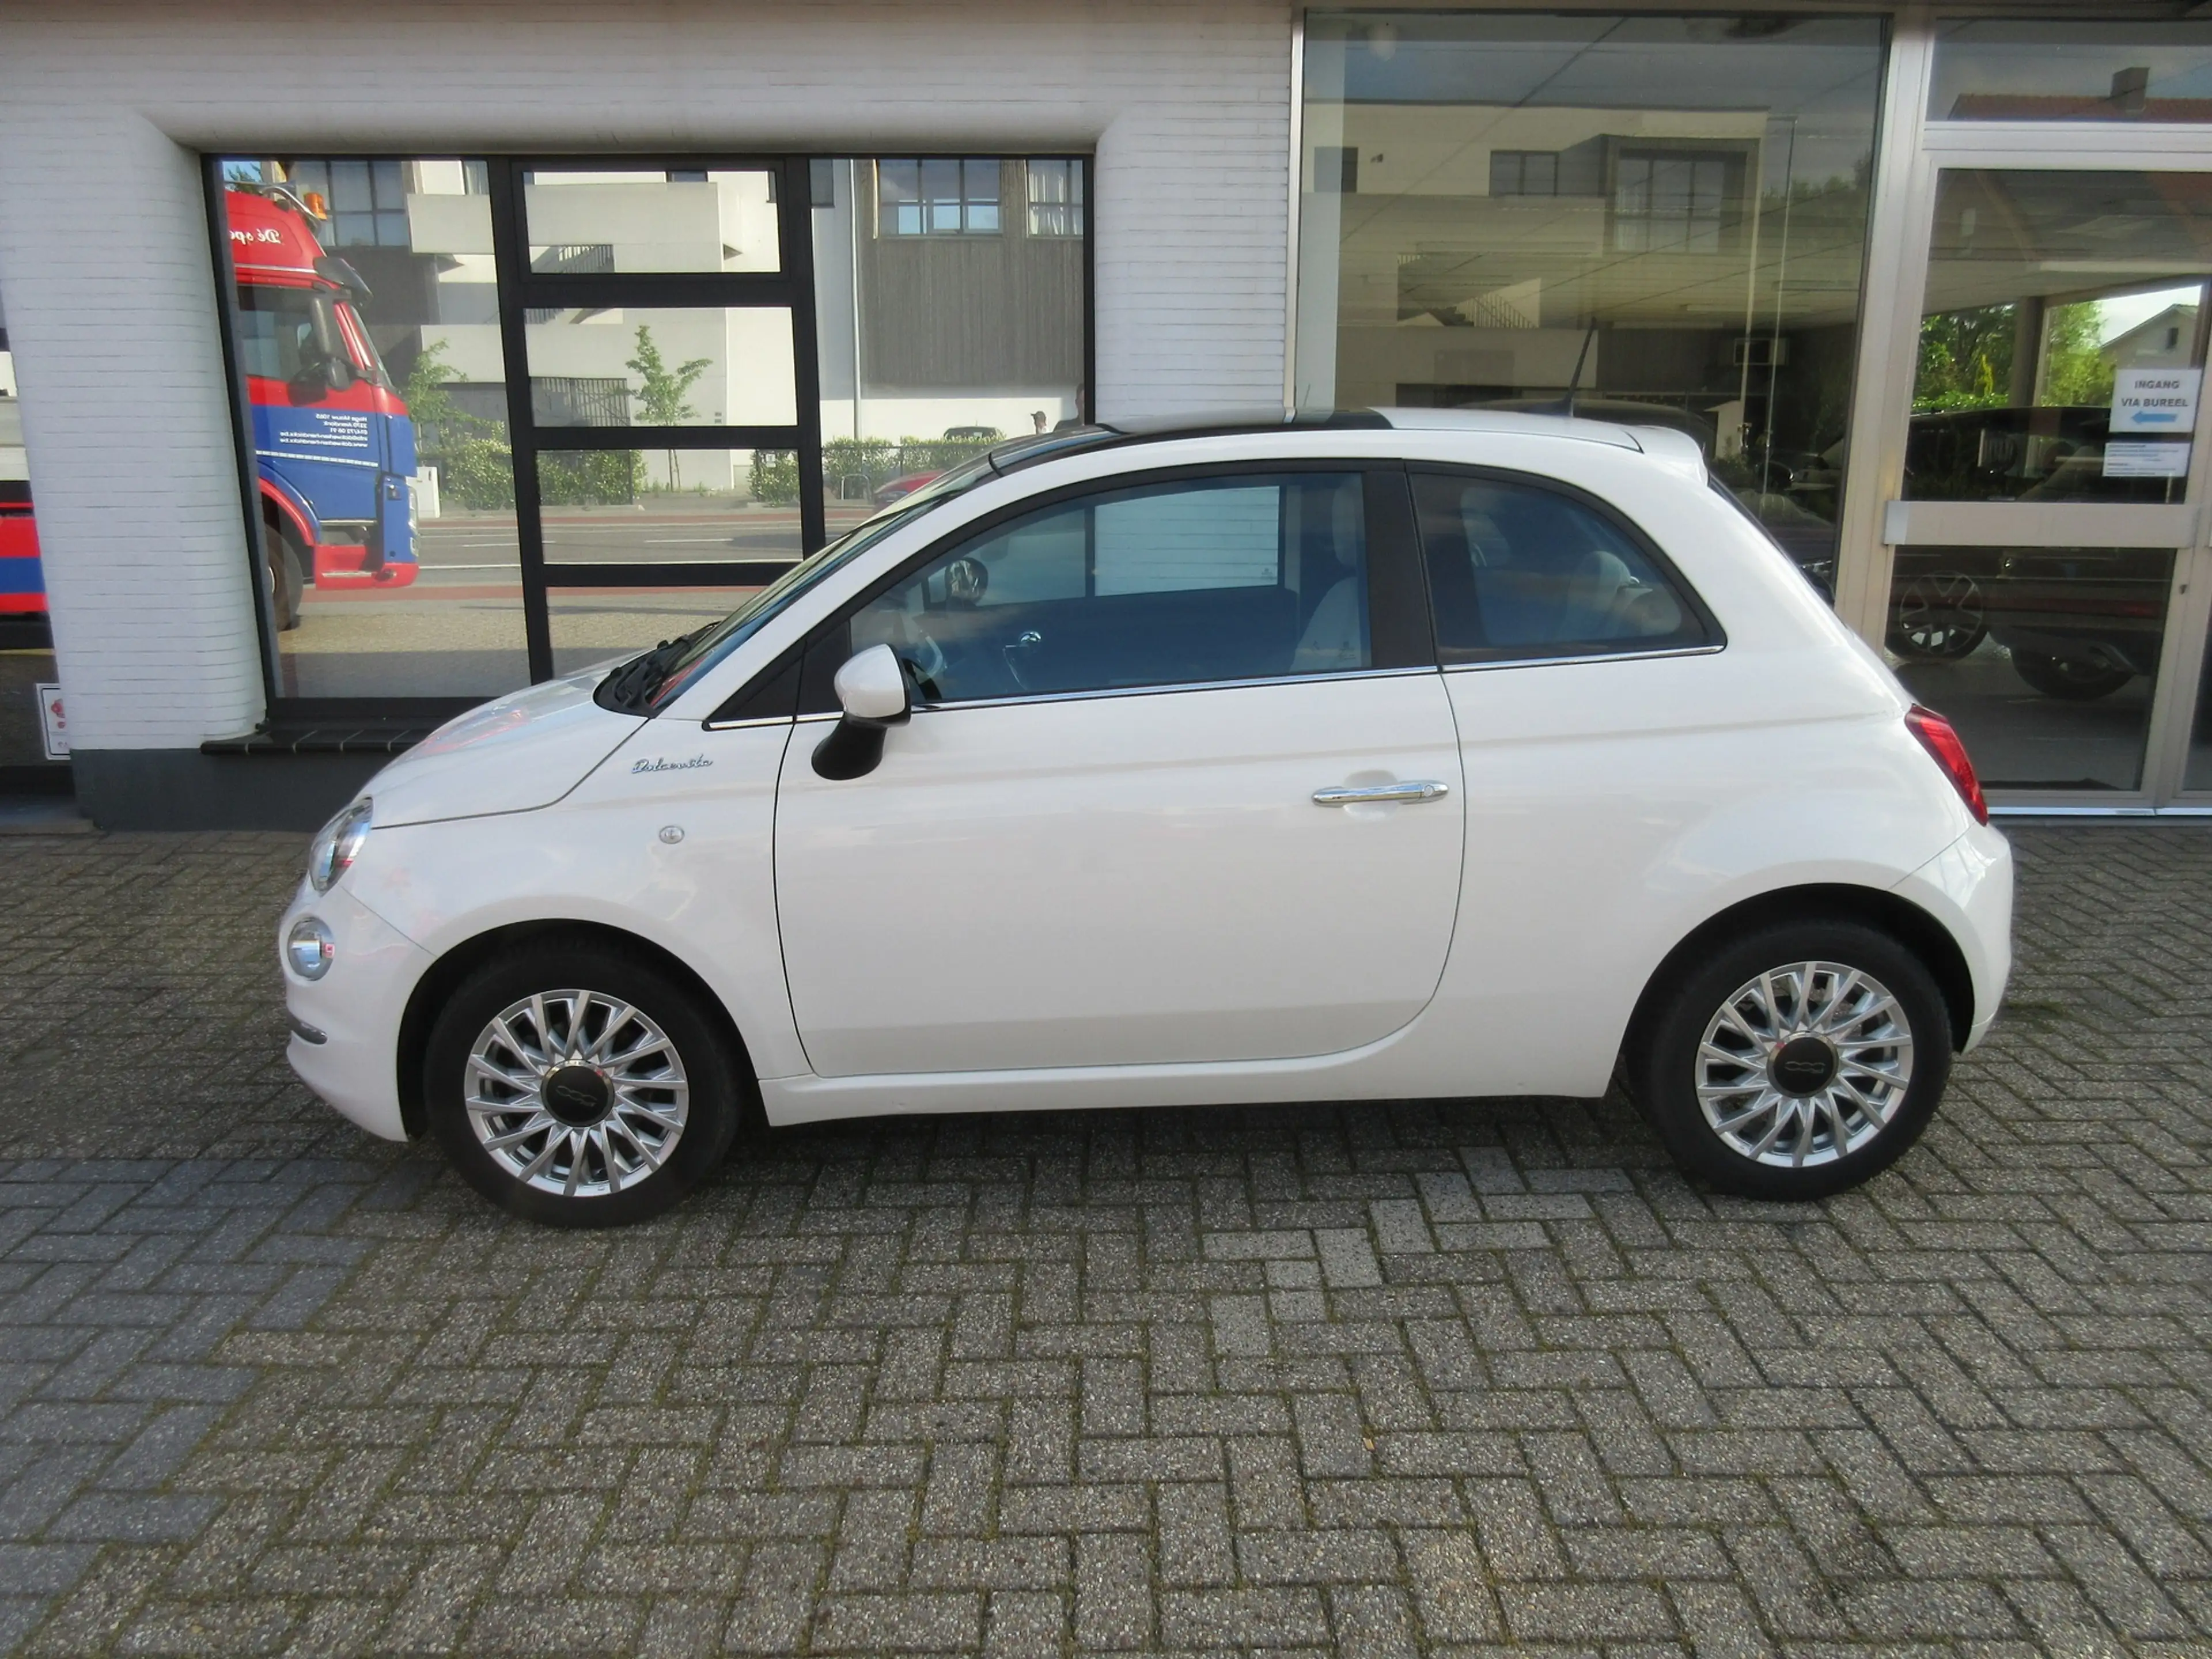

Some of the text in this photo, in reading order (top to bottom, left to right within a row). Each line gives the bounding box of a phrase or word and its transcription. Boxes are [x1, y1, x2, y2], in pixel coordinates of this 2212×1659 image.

[2134, 380, 2180, 389] INGANG
[2122, 398, 2188, 407] VIA BUREEL
